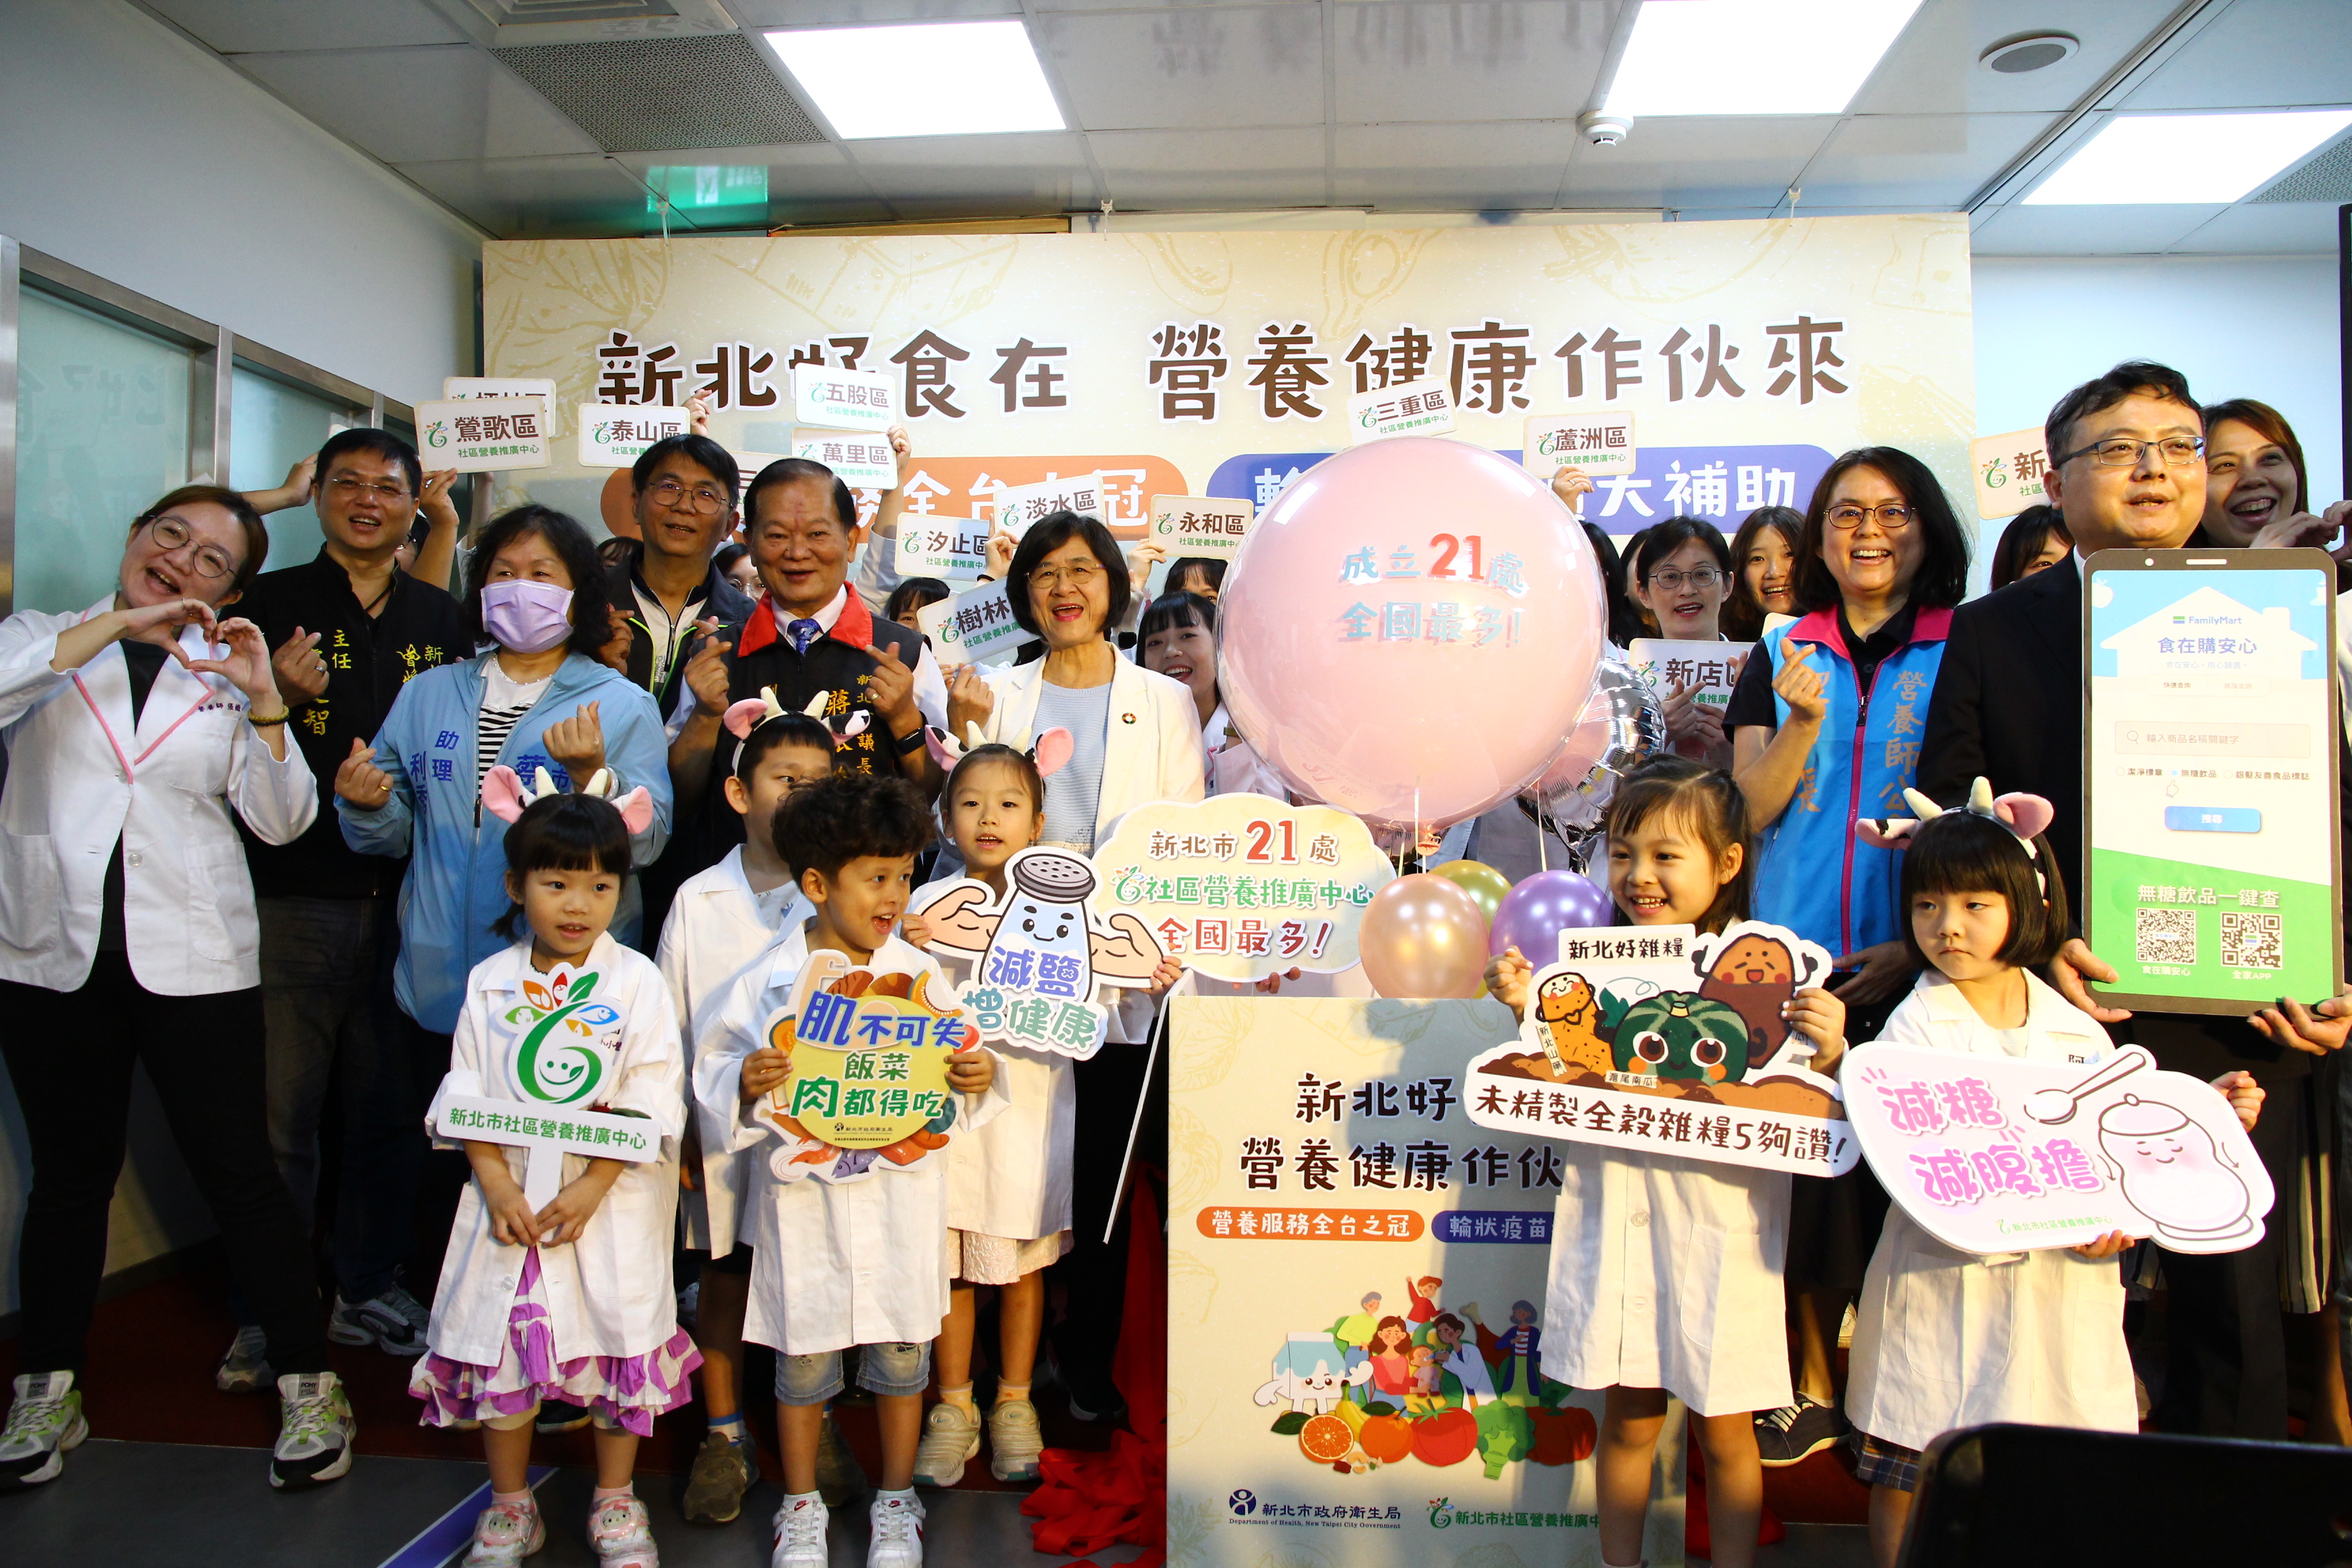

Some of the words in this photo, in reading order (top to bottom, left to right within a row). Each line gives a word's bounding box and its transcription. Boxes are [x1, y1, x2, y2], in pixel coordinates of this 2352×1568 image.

[1149, 316, 1850, 420] 營養健康作伙來
[826, 382, 889, 408] 五股區
[1376, 390, 1447, 422] 三重區
[826, 406, 889, 420] 社區營養推廣中心
[1379, 414, 1448, 434] 社區營養推廣中心
[455, 414, 539, 442] 鶯歌區
[612, 420, 681, 442] 泰山區
[1555, 426, 1627, 451] 蘆洲區
[458, 444, 539, 458] 社區營養推廣中心
[822, 443, 889, 465] 萬里區
[1555, 454, 1627, 465] 社區營養推廣中心
[2014, 449, 2053, 480] 新
[829, 468, 889, 477] 區營養推廣中心
[1576, 459, 1795, 520] 大補助
[1026, 489, 1097, 519] 淡水區
[1179, 512, 1245, 535] 永和區
[927, 530, 989, 556] 汐止區
[926, 557, 987, 569] 社區營養推廣中
[956, 596, 1010, 634] 樹林
[2189, 616, 2242, 625] FamilyMart
[332, 630, 353, 669] 主任
[2158, 637, 2257, 654] 食在購安心
[431, 730, 460, 782] 助理
[1879, 671, 1927, 819] 營養師公
[2180, 769, 2217, 779] 無糖飲品
[2201, 814, 2222, 824] 搜尋
[1145, 875, 1373, 908] 社區營養推廣中心
[2137, 885, 2280, 909] 無糖飲品一鍵查
[1568, 936, 1684, 960] 新北好雜糧
[990, 945, 1082, 997] 減鹽
[2232, 970, 2272, 980] 全家APP
[797, 990, 967, 1049] 肌不可失
[963, 987, 1097, 1049] 增健康
[1539, 1026, 1563, 1071] 新北山藥
[844, 1052, 911, 1081] 飯菜
[790, 1077, 943, 1118] 肉都得吃
[1296, 1073, 1457, 1123] 新北好
[1876, 1077, 2004, 1132] 減糖
[449, 1107, 647, 1150] 新北市社區營養推廣中心
[1240, 1137, 1563, 1191] 營養健康作伙
[1909, 1139, 2101, 1204] 減腹擔
[1211, 1210, 1410, 1237] 營養服務全台之冠
[1449, 1215, 1546, 1240] 輪狀疫苗
[2012, 1215, 2113, 1232] 新北市社區營養推廣中心
[1262, 1503, 1401, 1520] 新北市政府衛生局
